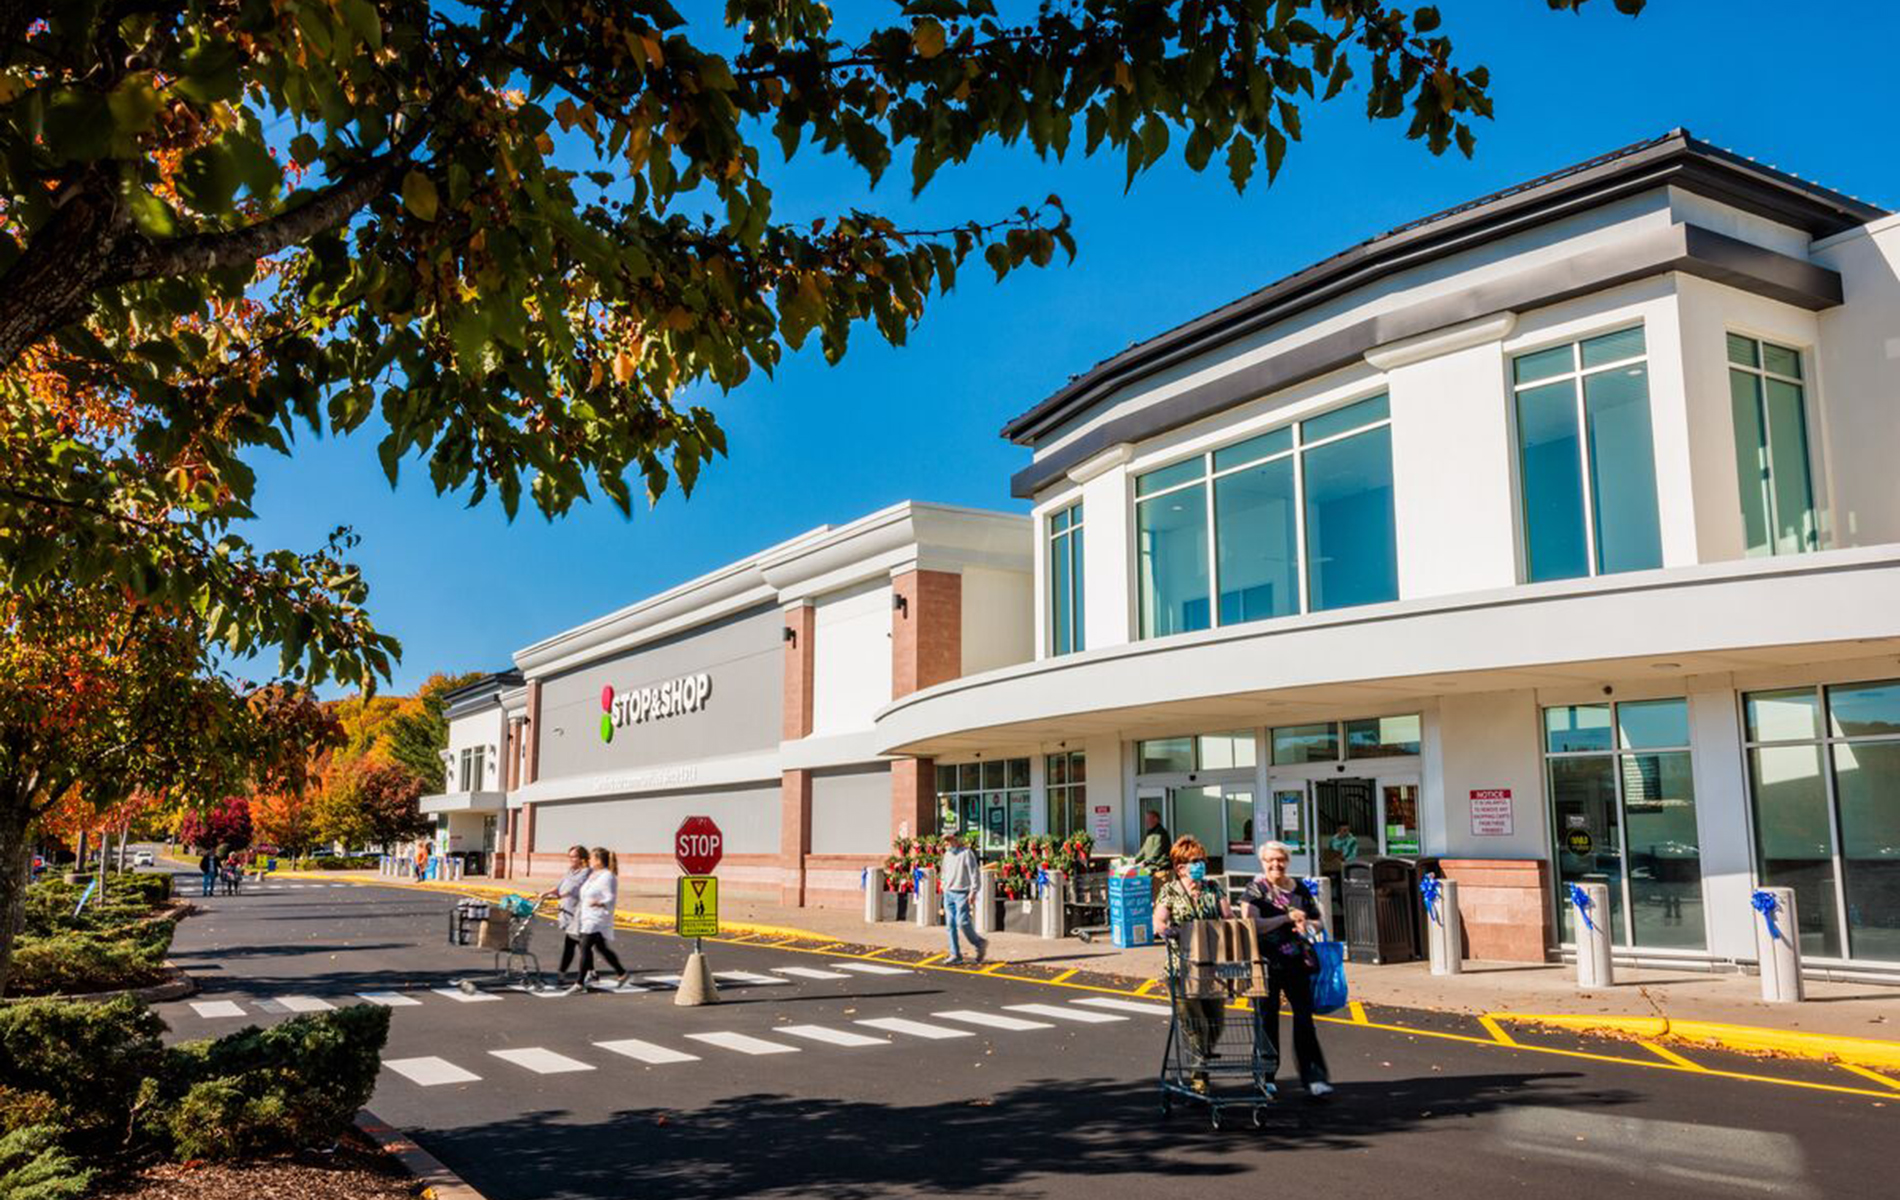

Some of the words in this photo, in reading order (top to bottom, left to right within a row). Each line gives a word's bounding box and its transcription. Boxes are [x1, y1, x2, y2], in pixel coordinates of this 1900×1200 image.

[611, 674, 711, 728] STOP&SHOP
[1476, 791, 1504, 799] NOTICE
[679, 834, 720, 857] STOP
